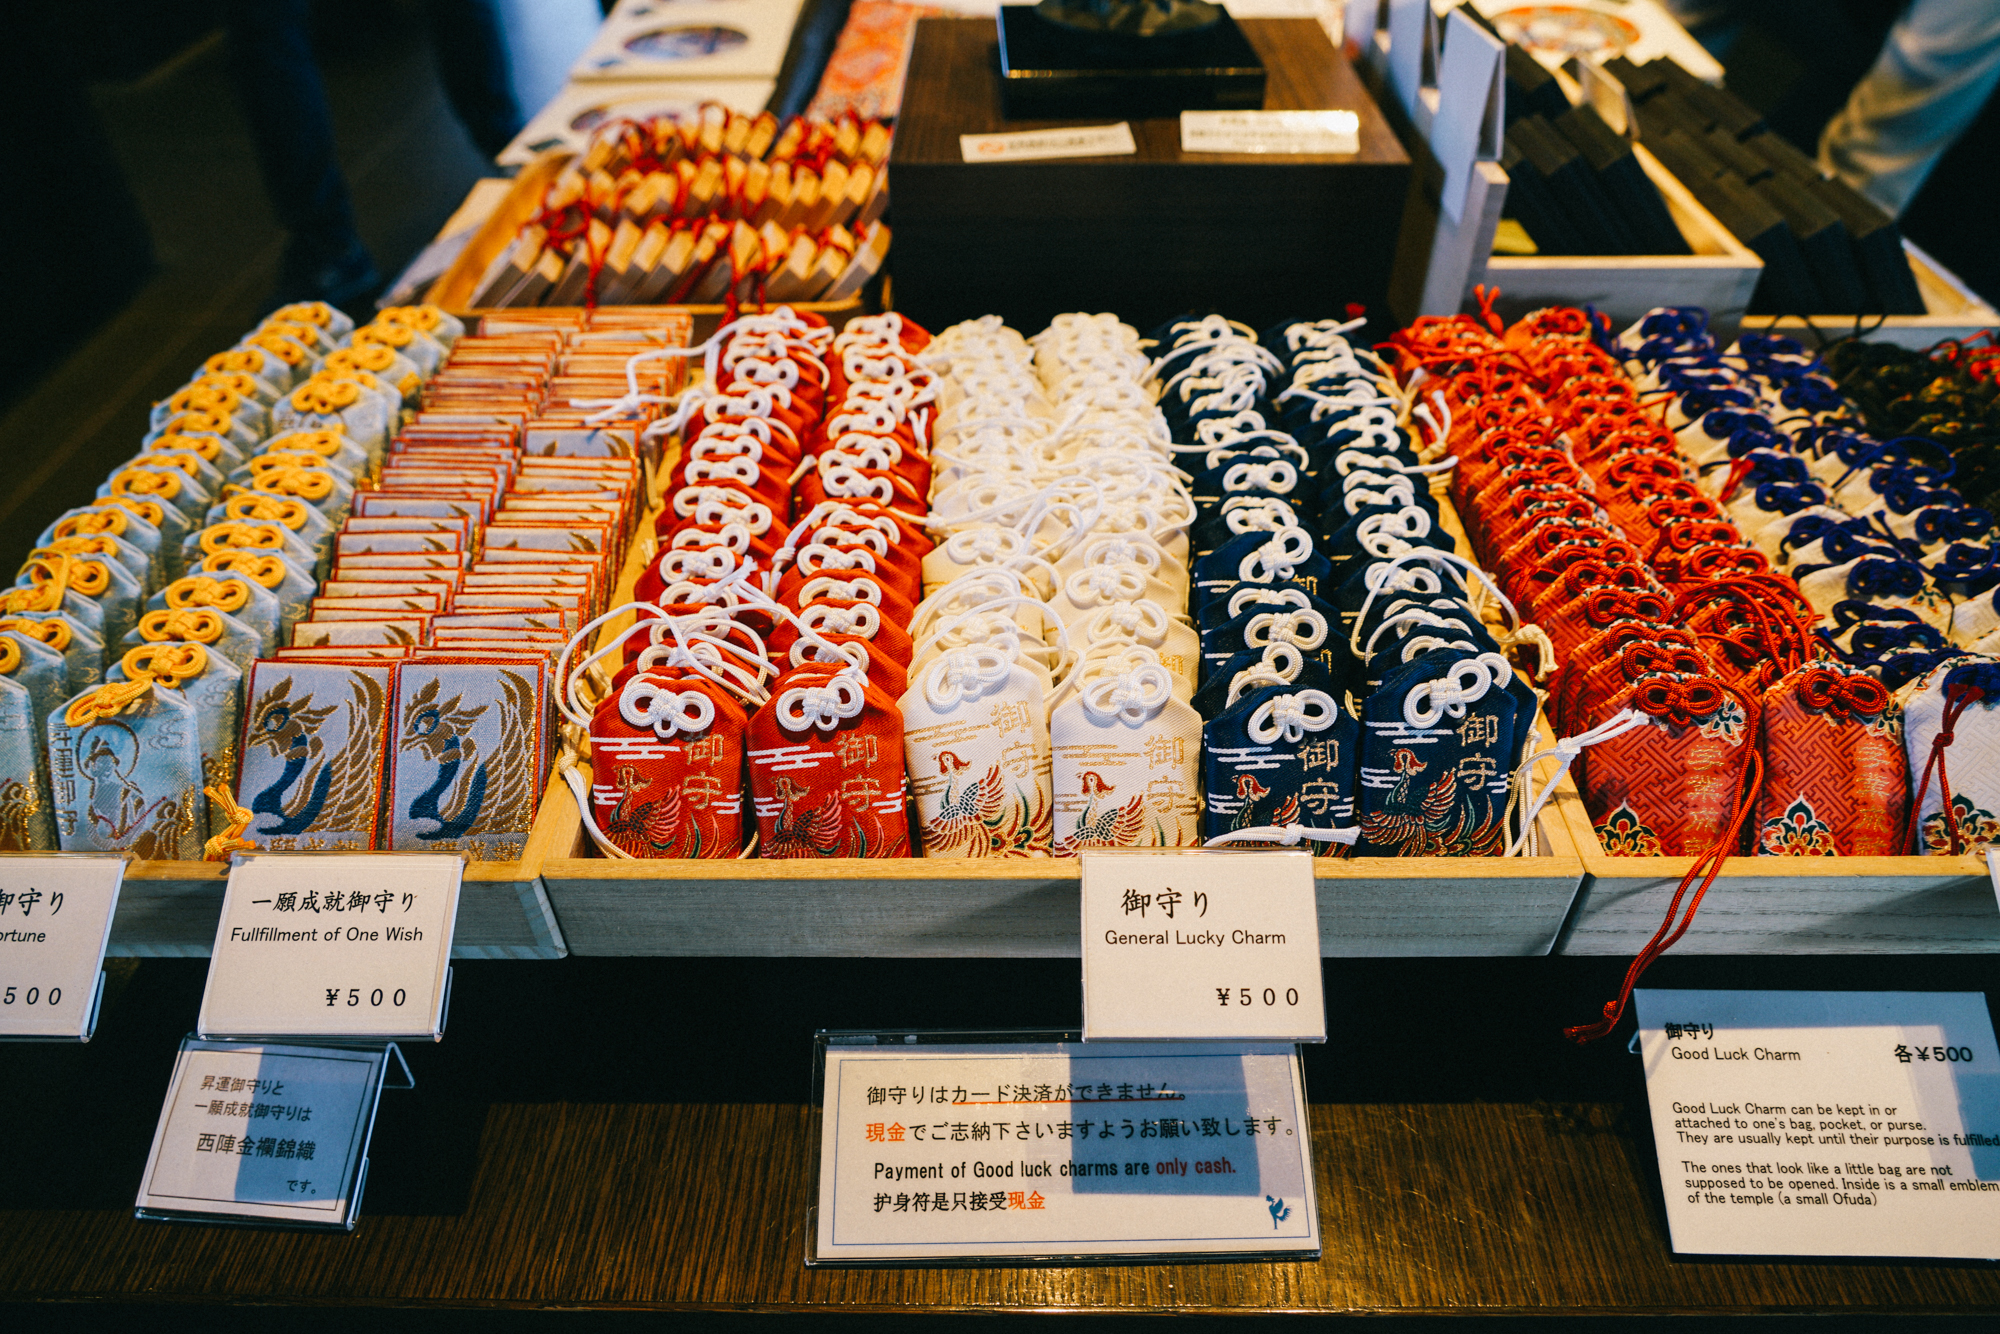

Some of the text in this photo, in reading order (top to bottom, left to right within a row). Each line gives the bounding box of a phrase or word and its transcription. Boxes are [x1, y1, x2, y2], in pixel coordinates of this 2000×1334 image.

[990, 700, 1038, 779] 御守
[1456, 712, 1499, 791] 御守
[682, 732, 724, 810] 御守
[836, 733, 882, 812] 御守
[1143, 734, 1184, 813] 御守
[1298, 736, 1339, 815] 御守
[252, 890, 413, 913] 一願成就御守り
[1121, 887, 1207, 919] 御守り
[231, 927, 422, 941] Fullfillment of One Wish
[1105, 930, 1285, 947] General Lucky Charm
[326, 989, 406, 1006] ¥500
[1216, 988, 1298, 1006] ¥500
[1665, 1022, 1713, 1040] 御守り
[1672, 1047, 1801, 1060] Good Luck Charm
[1894, 1044, 1972, 1063] 各¥500
[200, 1075, 284, 1095] 昇運御守りと
[867, 1083, 1186, 1105] 御守りはカード決済ができません。
[195, 1100, 312, 1122] 一願成就御守りは
[1672, 1102, 1706, 1114] Good
[1710, 1103, 1741, 1114] Luck
[1745, 1103, 1786, 1114] Charm
[1817, 1104, 1832, 1115] be
[1836, 1104, 1865, 1117] kept
[1868, 1104, 1880, 1115] in
[866, 1116, 1294, 1142] 現金でご志納下さいますようお願い致します。
[1675, 1117, 1730, 1128] attached
[1734, 1119, 1748, 1129] to
[1753, 1117, 1785, 1129] one's
[1870, 1122, 1883, 1130] or
[1887, 1122, 1926, 1132] purse.
[196, 1133, 316, 1160] 西陣金襴錦織
[1676, 1131, 1708, 1145] They
[1714, 1135, 1733, 1143] are
[1738, 1132, 1781, 1146] usually
[1785, 1133, 1814, 1146] kept
[1818, 1133, 1846, 1144] until
[1849, 1133, 1879, 1144] their
[1884, 1137, 1935, 1147] purpose
[1938, 1134, 1950, 1145] is
[875, 1156, 1235, 1181] Payment of Good luck charms are only cash.
[1681, 1161, 1953, 1177] The ones that look like a little bag are not
[287, 1179, 316, 1194] です。
[1685, 1177, 2000, 1191] supposed to be opened. Inside is a small emblem
[874, 1191, 1046, 1213] 护身符是只接受现金
[1688, 1191, 1877, 1206] of the temple (a small Ofuda)
